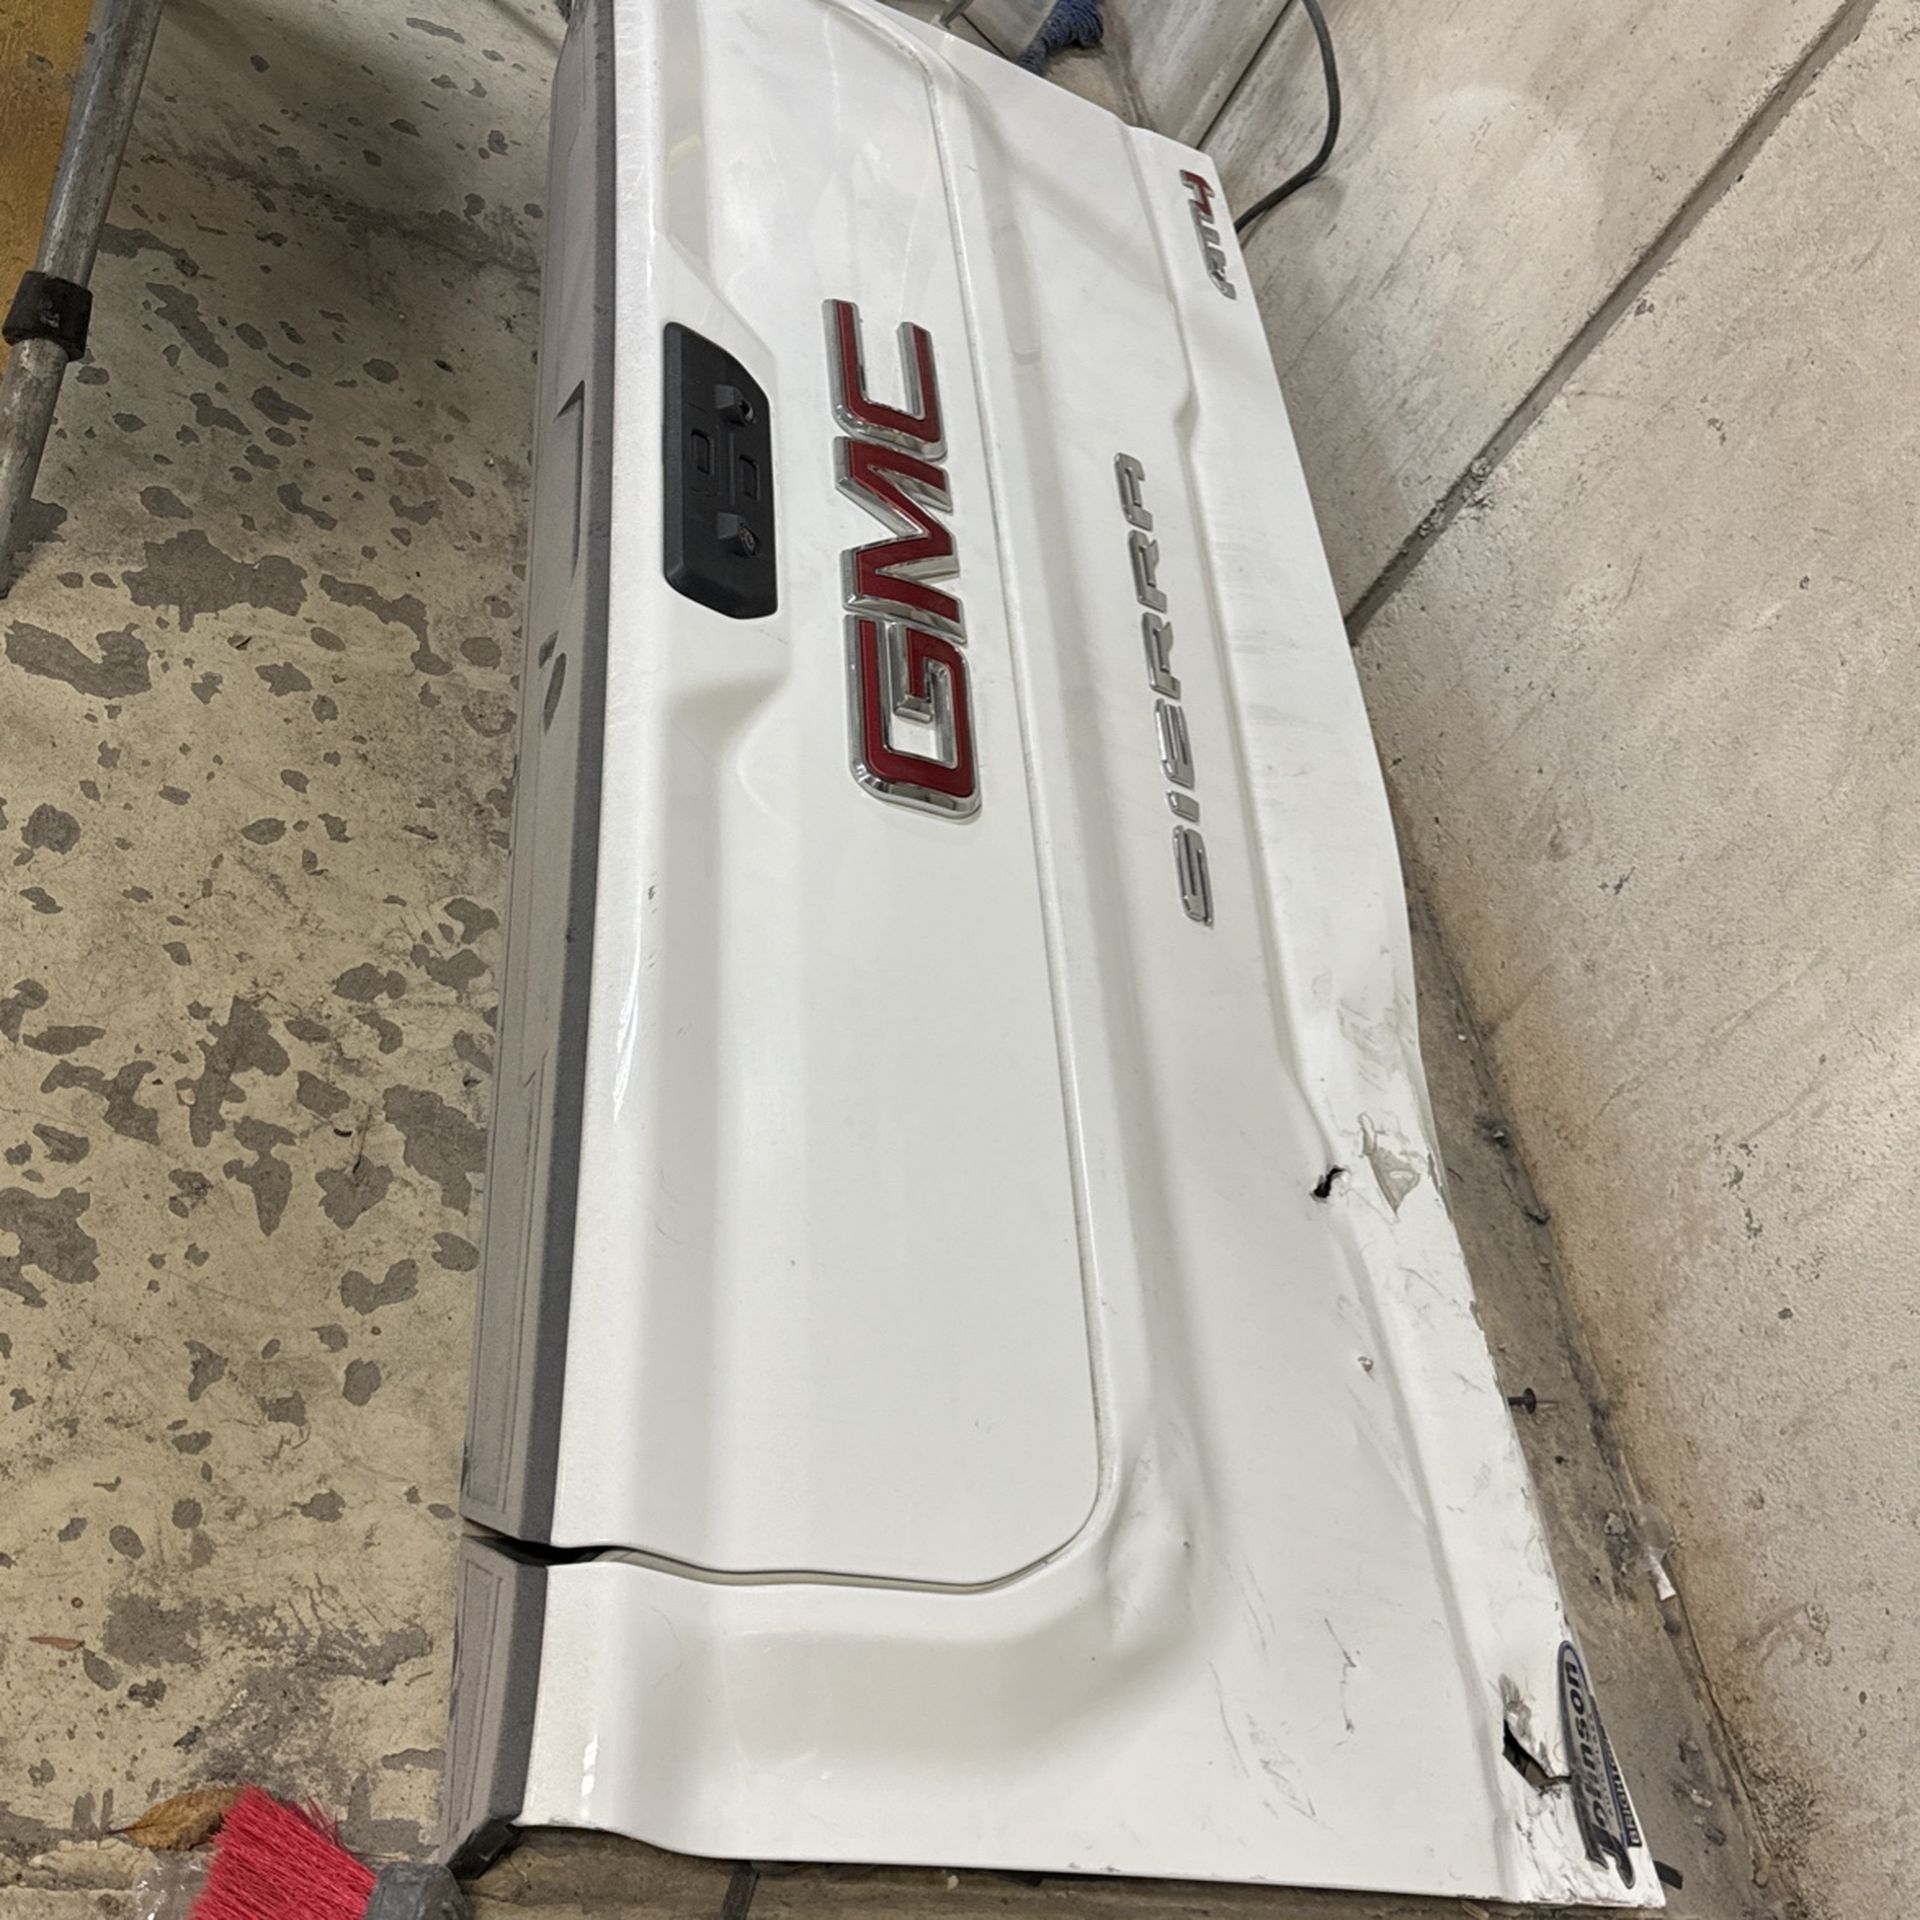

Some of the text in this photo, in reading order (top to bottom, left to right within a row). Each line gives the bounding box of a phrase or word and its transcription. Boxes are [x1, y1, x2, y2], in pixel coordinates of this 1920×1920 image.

[1179, 169, 1237, 300] AT4
[822, 299, 982, 824] GMC
[1114, 452, 1214, 927] SIERRA
[1564, 1660, 1636, 1890] Johnson
